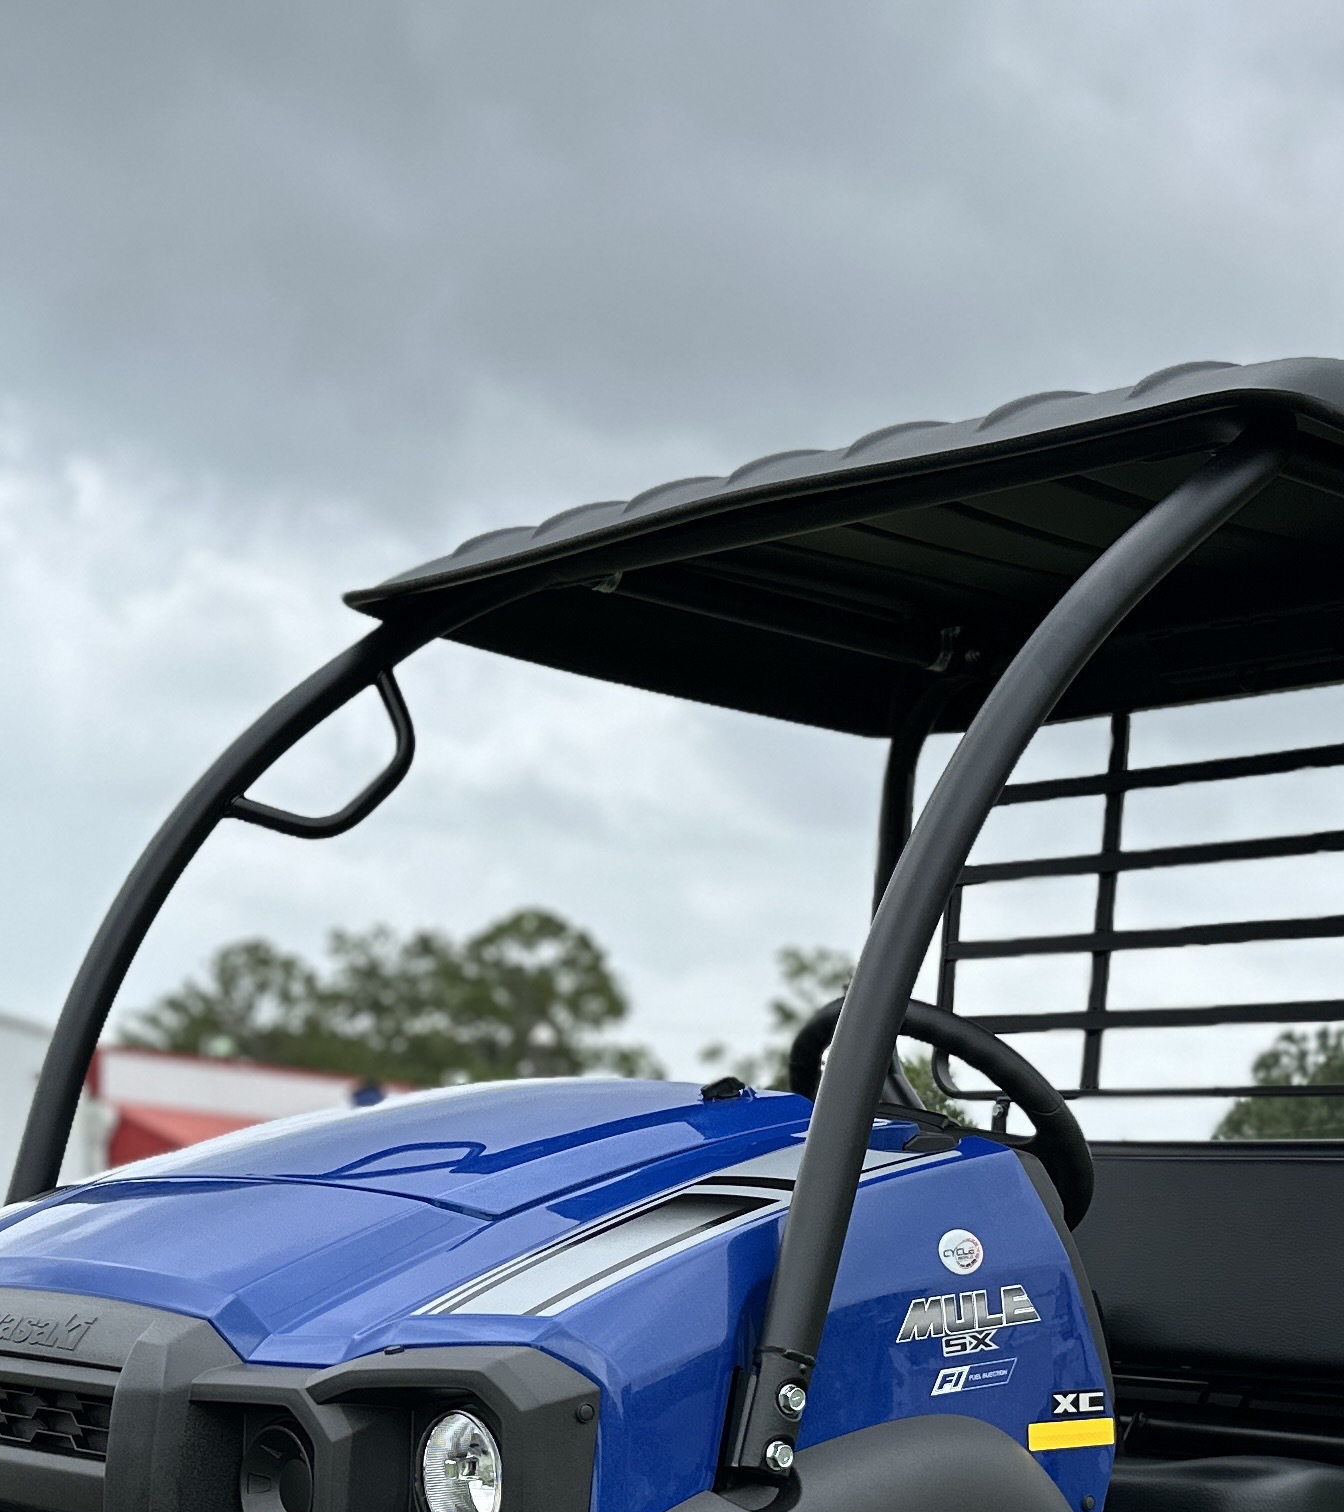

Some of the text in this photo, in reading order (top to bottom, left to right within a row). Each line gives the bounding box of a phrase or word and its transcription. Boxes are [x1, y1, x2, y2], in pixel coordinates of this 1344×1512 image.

[943, 1246, 975, 1258] CYCLE
[896, 1284, 1041, 1343] MULE
[942, 1330, 999, 1357] SX
[935, 1368, 966, 1392] FI
[1053, 1392, 1105, 1414] XC
